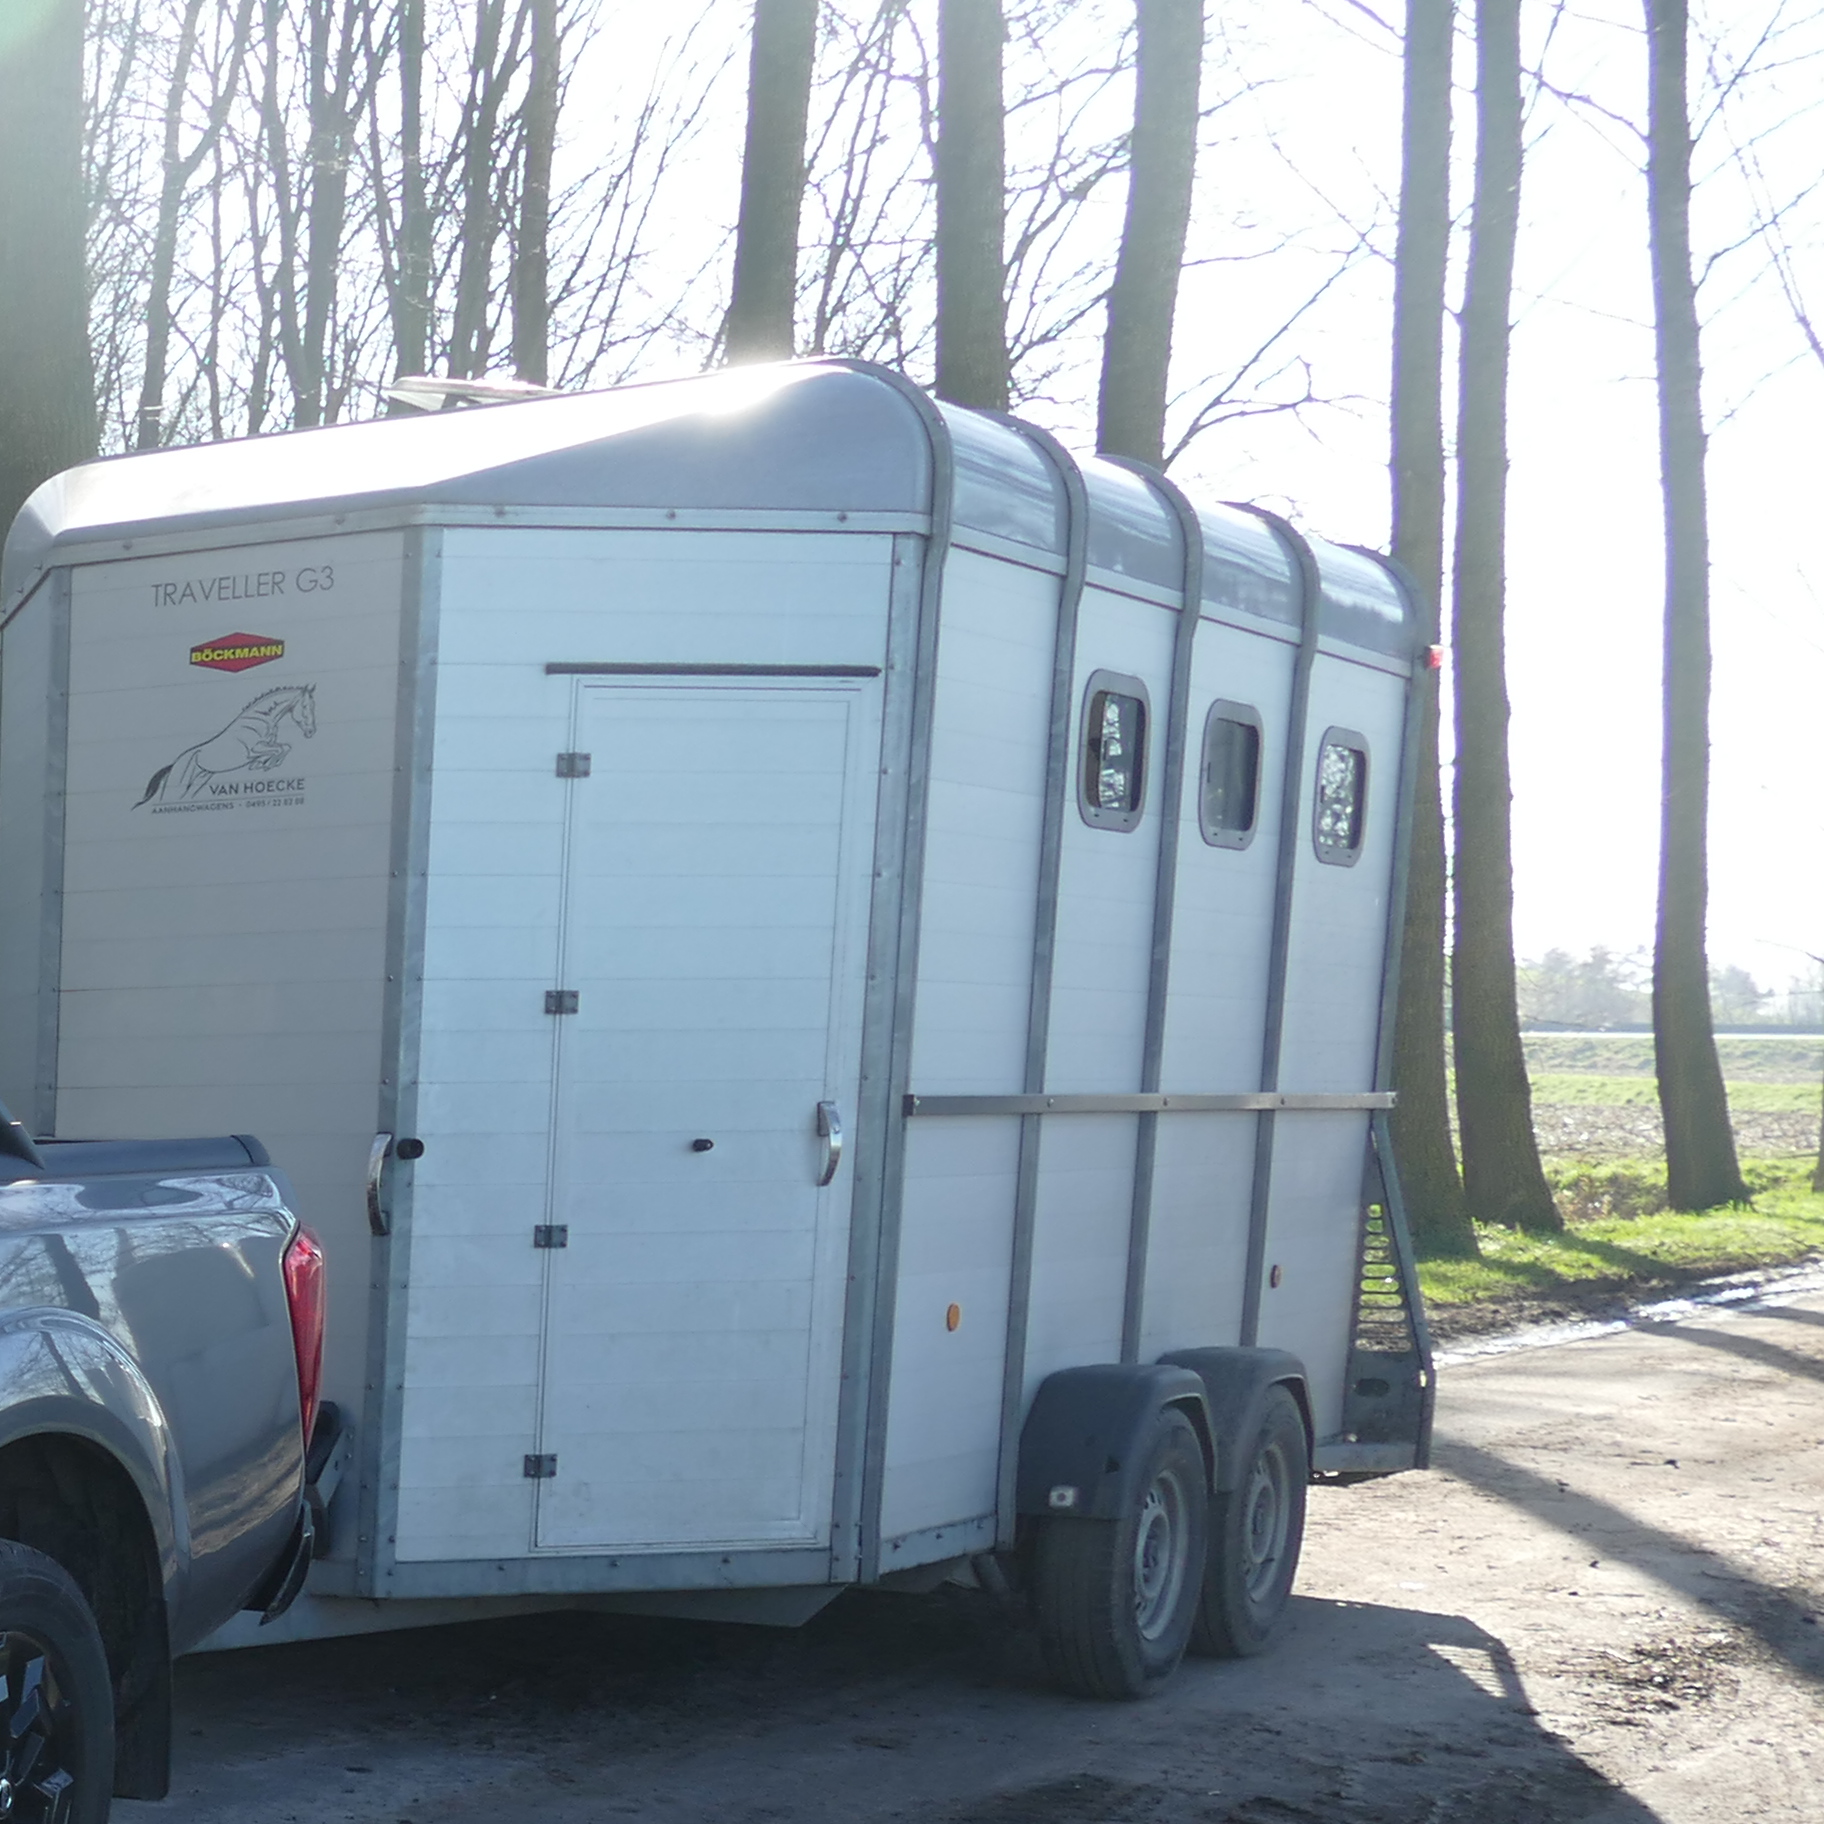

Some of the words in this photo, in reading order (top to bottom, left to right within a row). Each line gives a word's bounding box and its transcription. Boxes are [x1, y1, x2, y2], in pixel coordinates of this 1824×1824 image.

[151, 570, 286, 607] TRAVELLER
[295, 565, 335, 593] G3
[190, 644, 283, 663] BÖCKMANN
[209, 782, 240, 796] VAN
[243, 778, 305, 794] HOECKE
